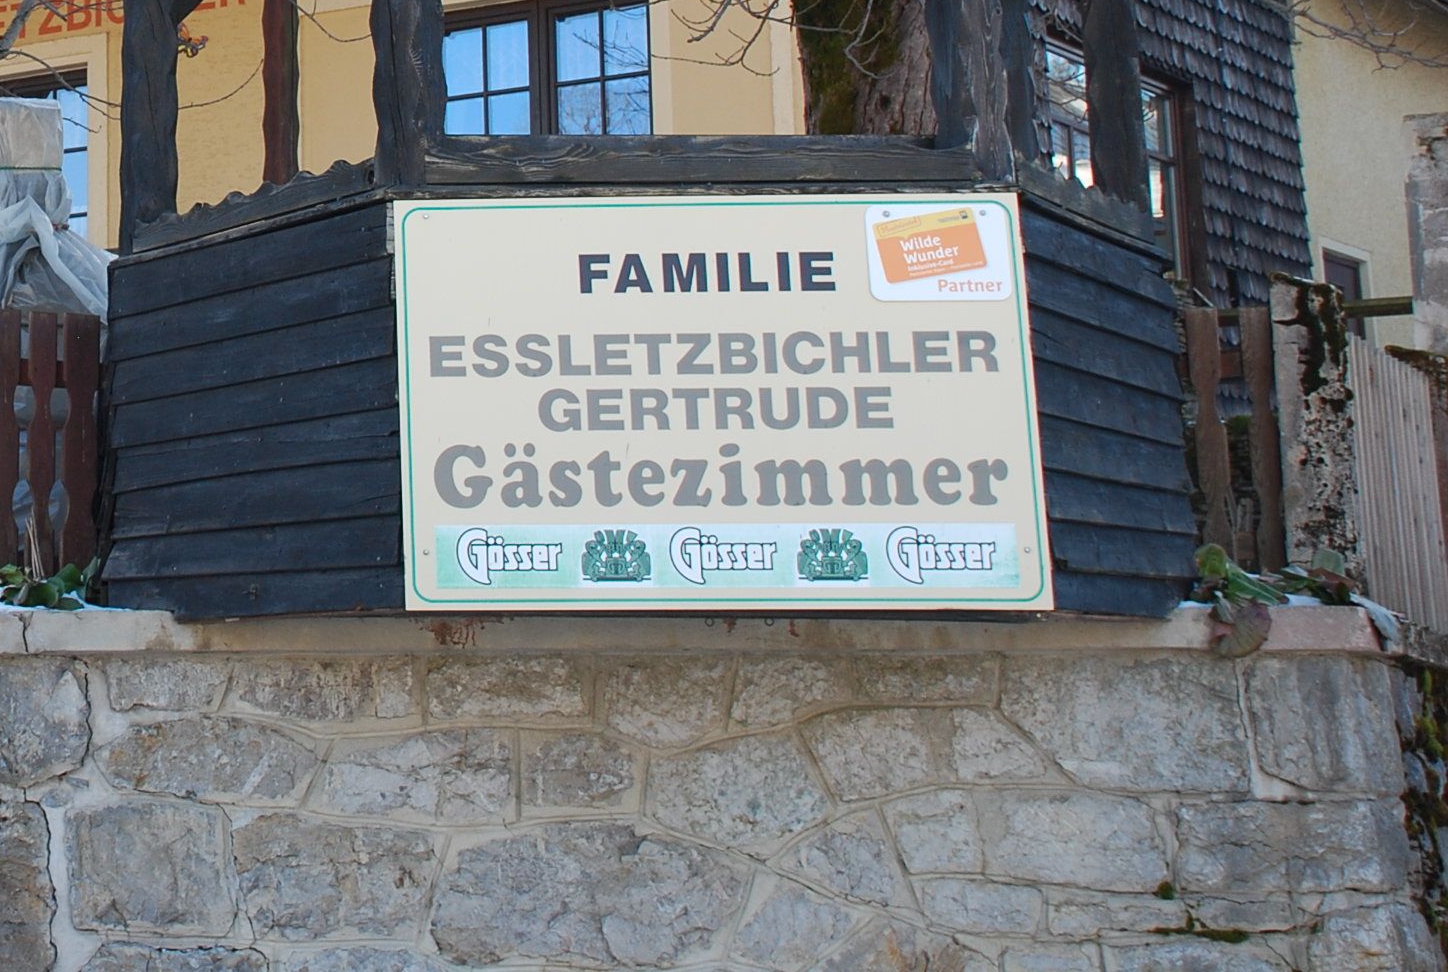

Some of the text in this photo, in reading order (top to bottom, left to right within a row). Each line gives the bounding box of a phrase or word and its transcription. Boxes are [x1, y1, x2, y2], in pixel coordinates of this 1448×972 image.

[899, 235, 941, 252] Wilde
[903, 246, 959, 264] Wunder
[578, 251, 837, 294] FAMILIE
[937, 279, 1003, 292] Partner
[428, 331, 999, 377] ESSLETZBICHLER
[538, 387, 894, 432] GERTRUDE
[433, 443, 1009, 508] Gästezimmer
[456, 527, 562, 585] Gösser
[669, 526, 778, 585] Gösser
[886, 526, 995, 584] Gösser
